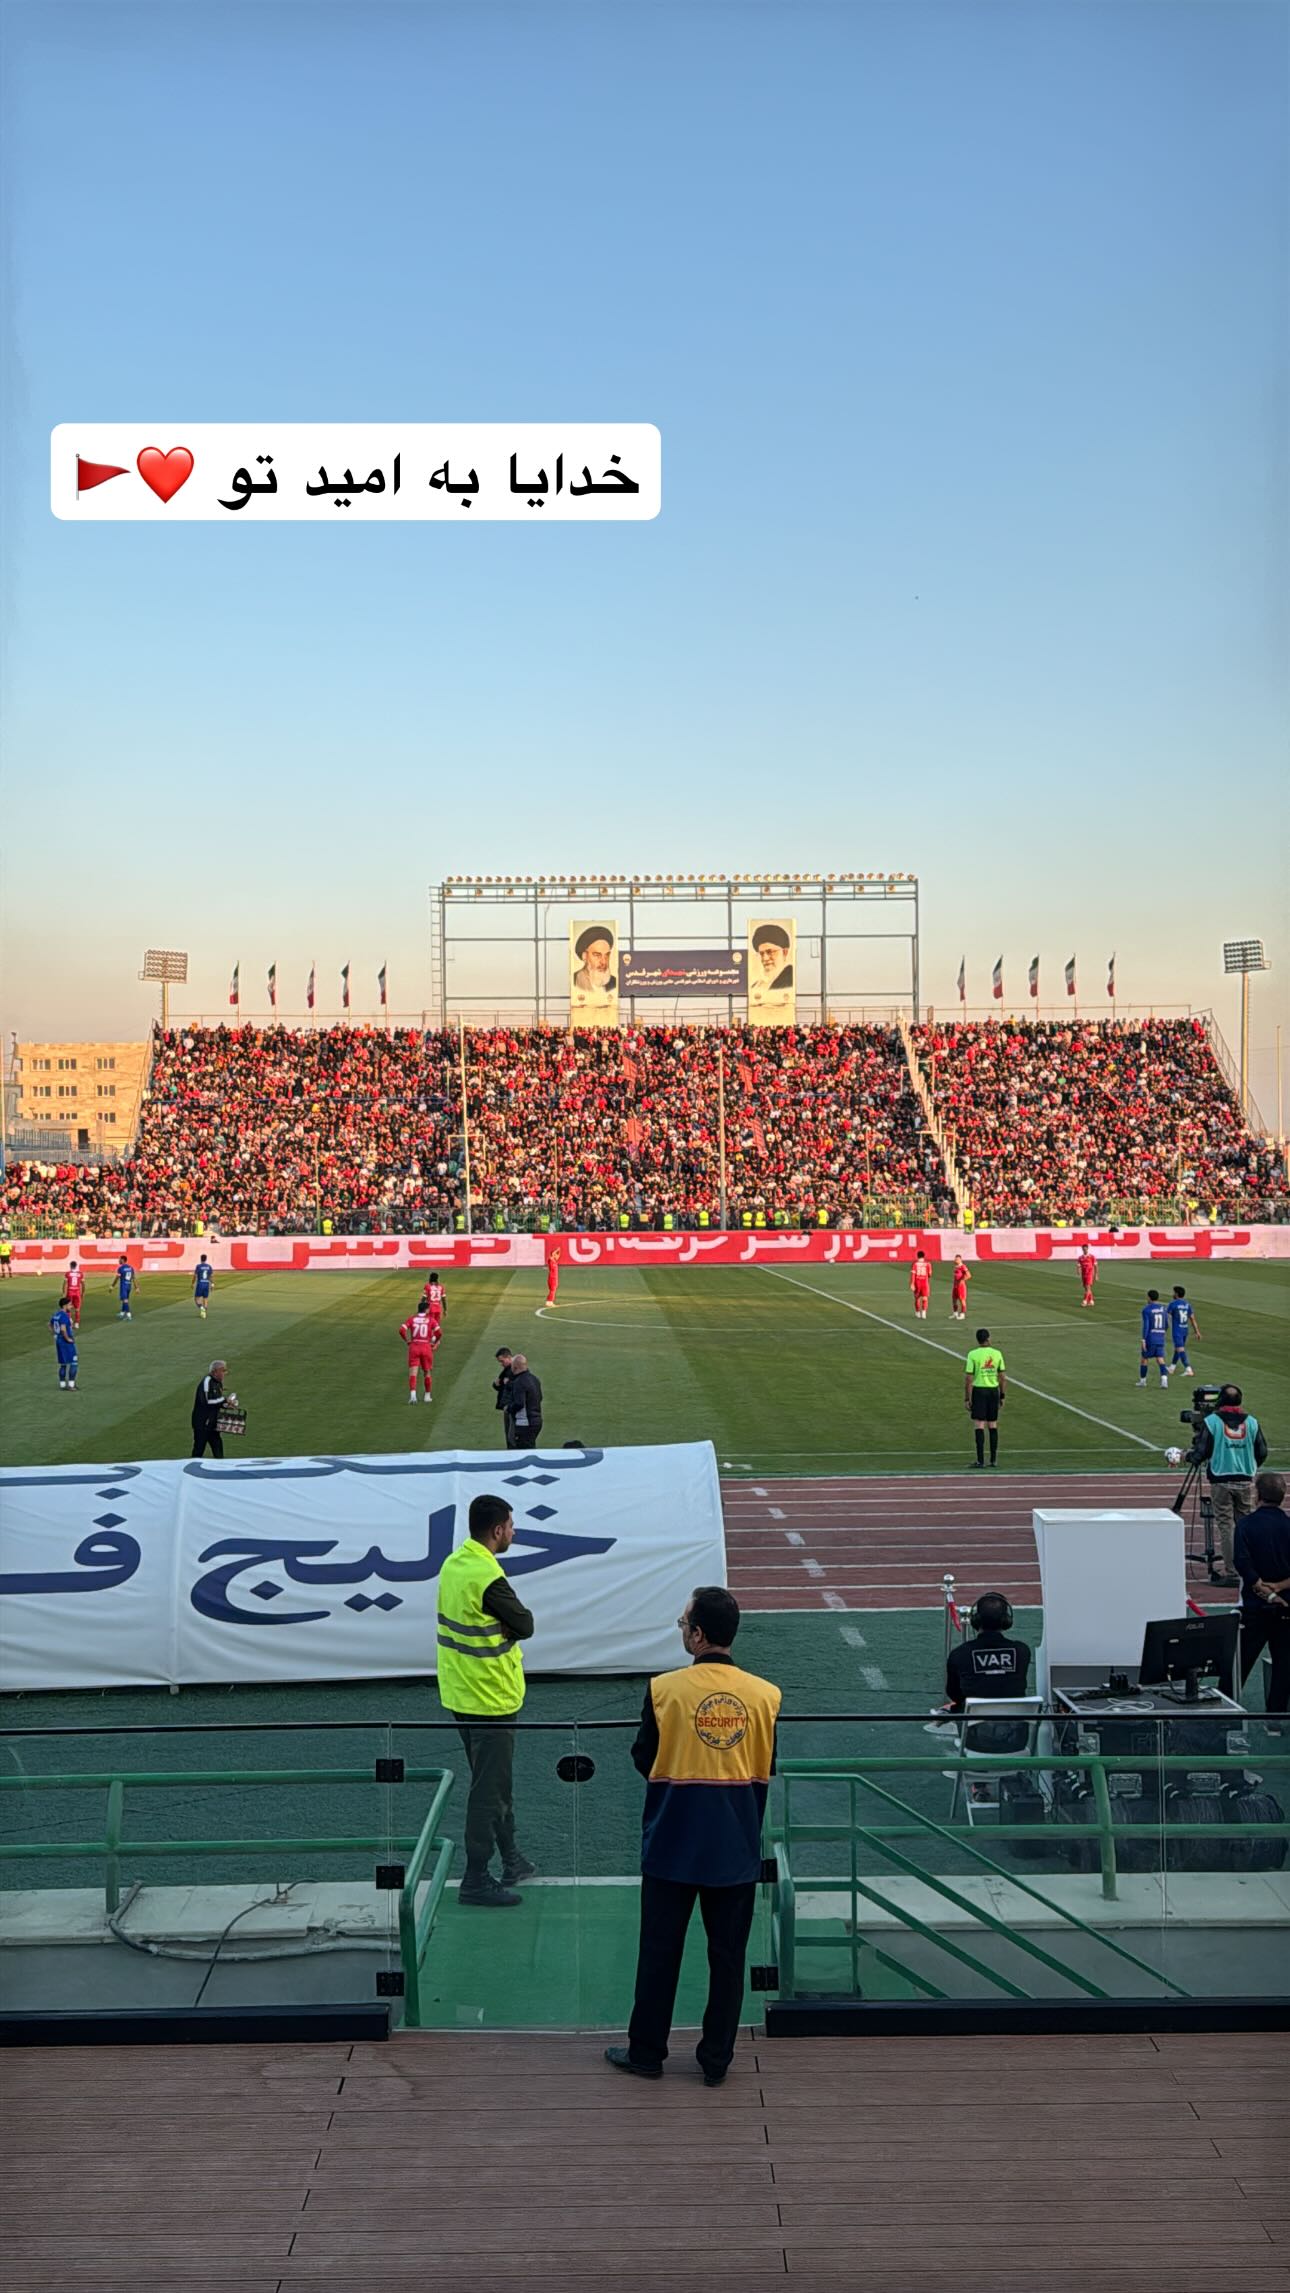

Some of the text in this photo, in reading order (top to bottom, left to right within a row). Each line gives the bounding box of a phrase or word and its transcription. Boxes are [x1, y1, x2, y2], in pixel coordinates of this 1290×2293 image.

[412, 1323, 428, 1338] 70
[190, 1503, 617, 1625] خلیج
[976, 1653, 1013, 1667] VAR
[697, 1716, 746, 1728] SECURITY
